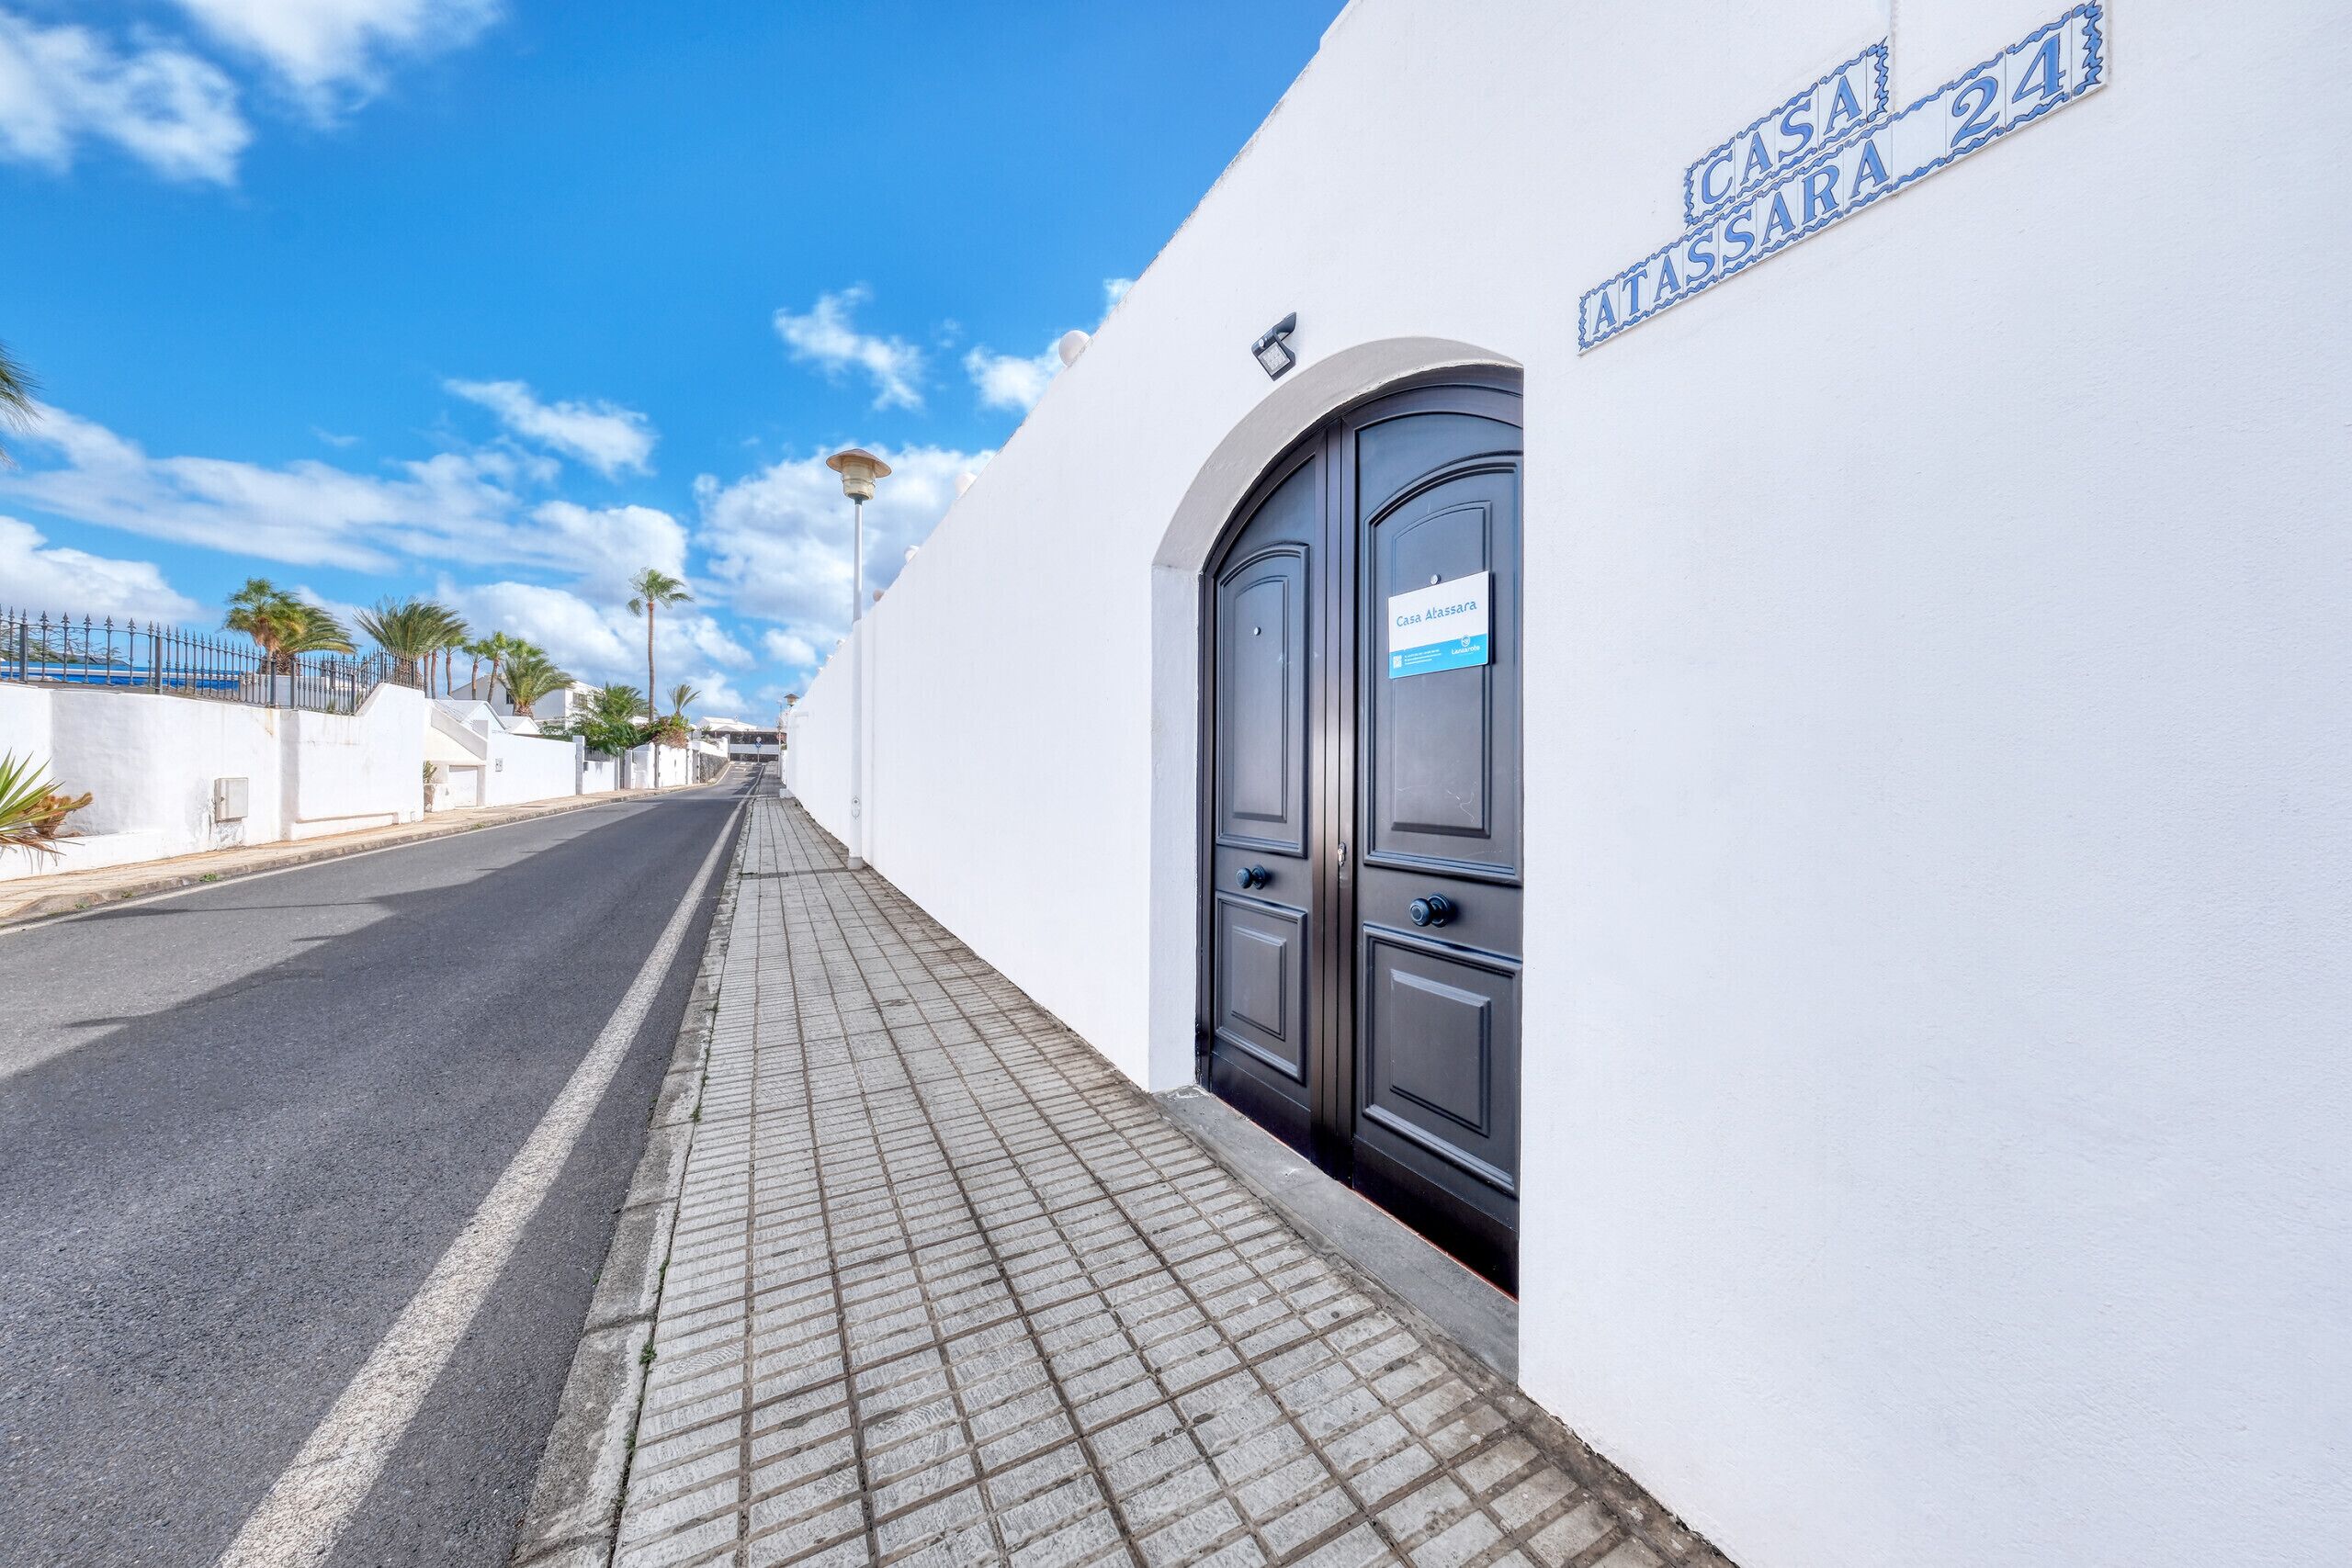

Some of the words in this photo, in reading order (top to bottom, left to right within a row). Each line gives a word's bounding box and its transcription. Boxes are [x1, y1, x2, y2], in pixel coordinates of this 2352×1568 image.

[1592, 139, 1891, 335] ATASSARA
[1951, 33, 2067, 148] 24
[1700, 75, 1862, 205] CASA
[1396, 614, 1421, 627] Casa
[1425, 601, 1477, 620] Atassara
